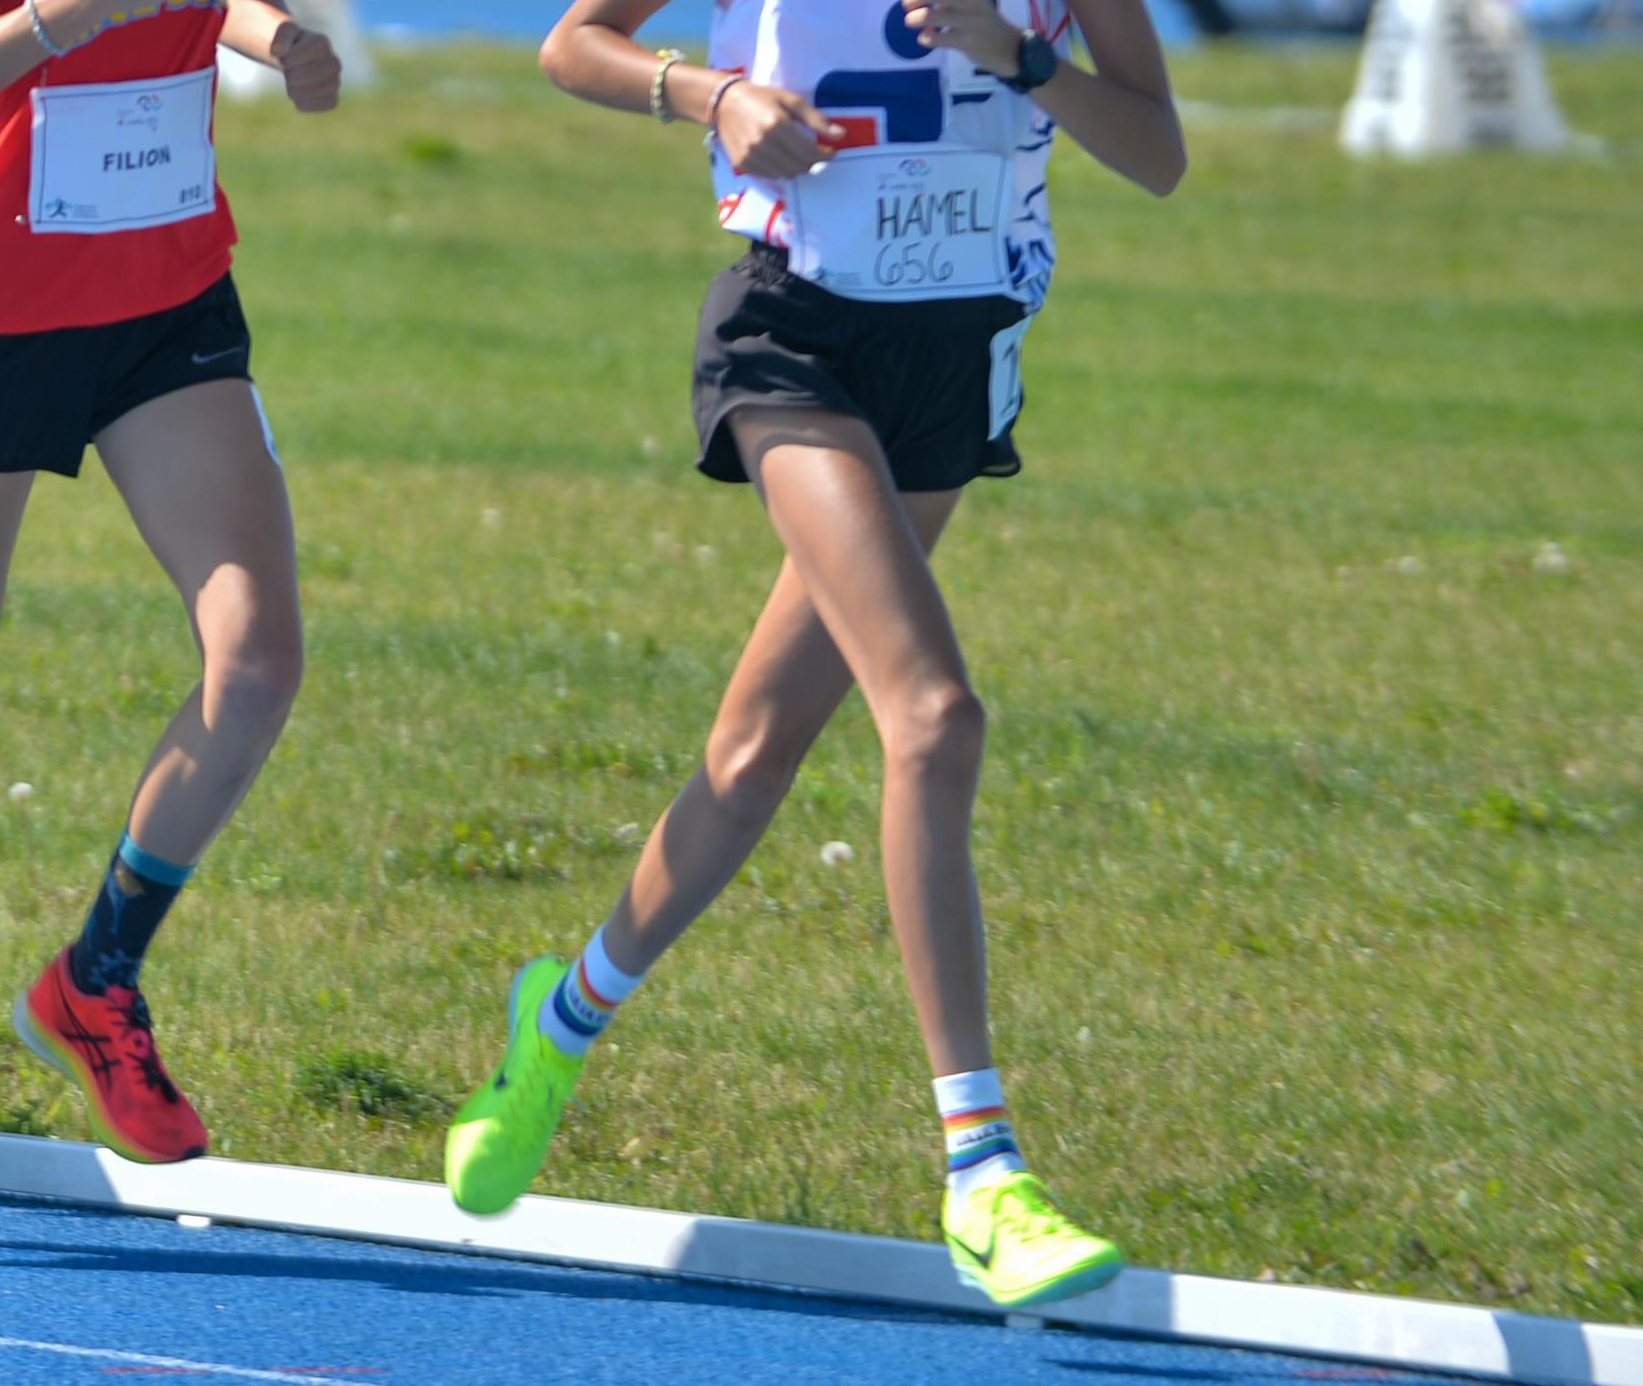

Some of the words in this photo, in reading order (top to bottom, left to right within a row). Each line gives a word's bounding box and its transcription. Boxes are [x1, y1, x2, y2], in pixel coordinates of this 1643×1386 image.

[102, 145, 171, 172] FILION
[875, 188, 993, 241] HAMEL
[873, 242, 954, 287] 656
